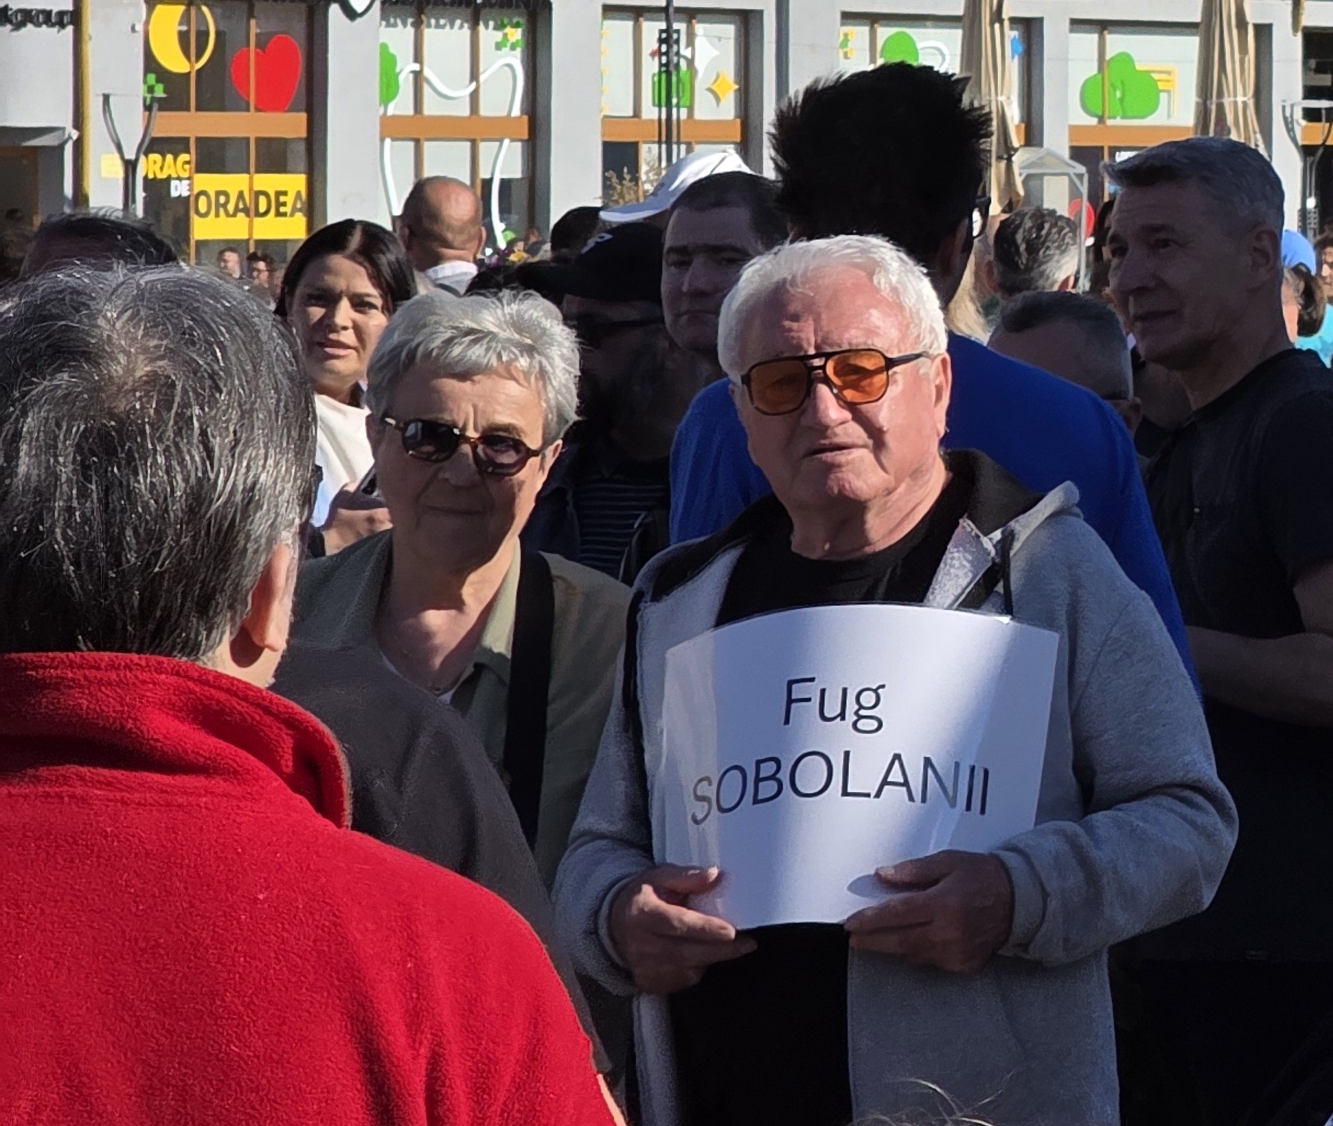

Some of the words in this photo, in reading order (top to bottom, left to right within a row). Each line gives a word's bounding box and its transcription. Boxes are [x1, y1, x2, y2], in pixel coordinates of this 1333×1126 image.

[170, 180, 190, 197] DE
[194, 190, 307, 218] ORADEA
[783, 676, 886, 735] Fug
[690, 750, 990, 826] SOBOLANII
